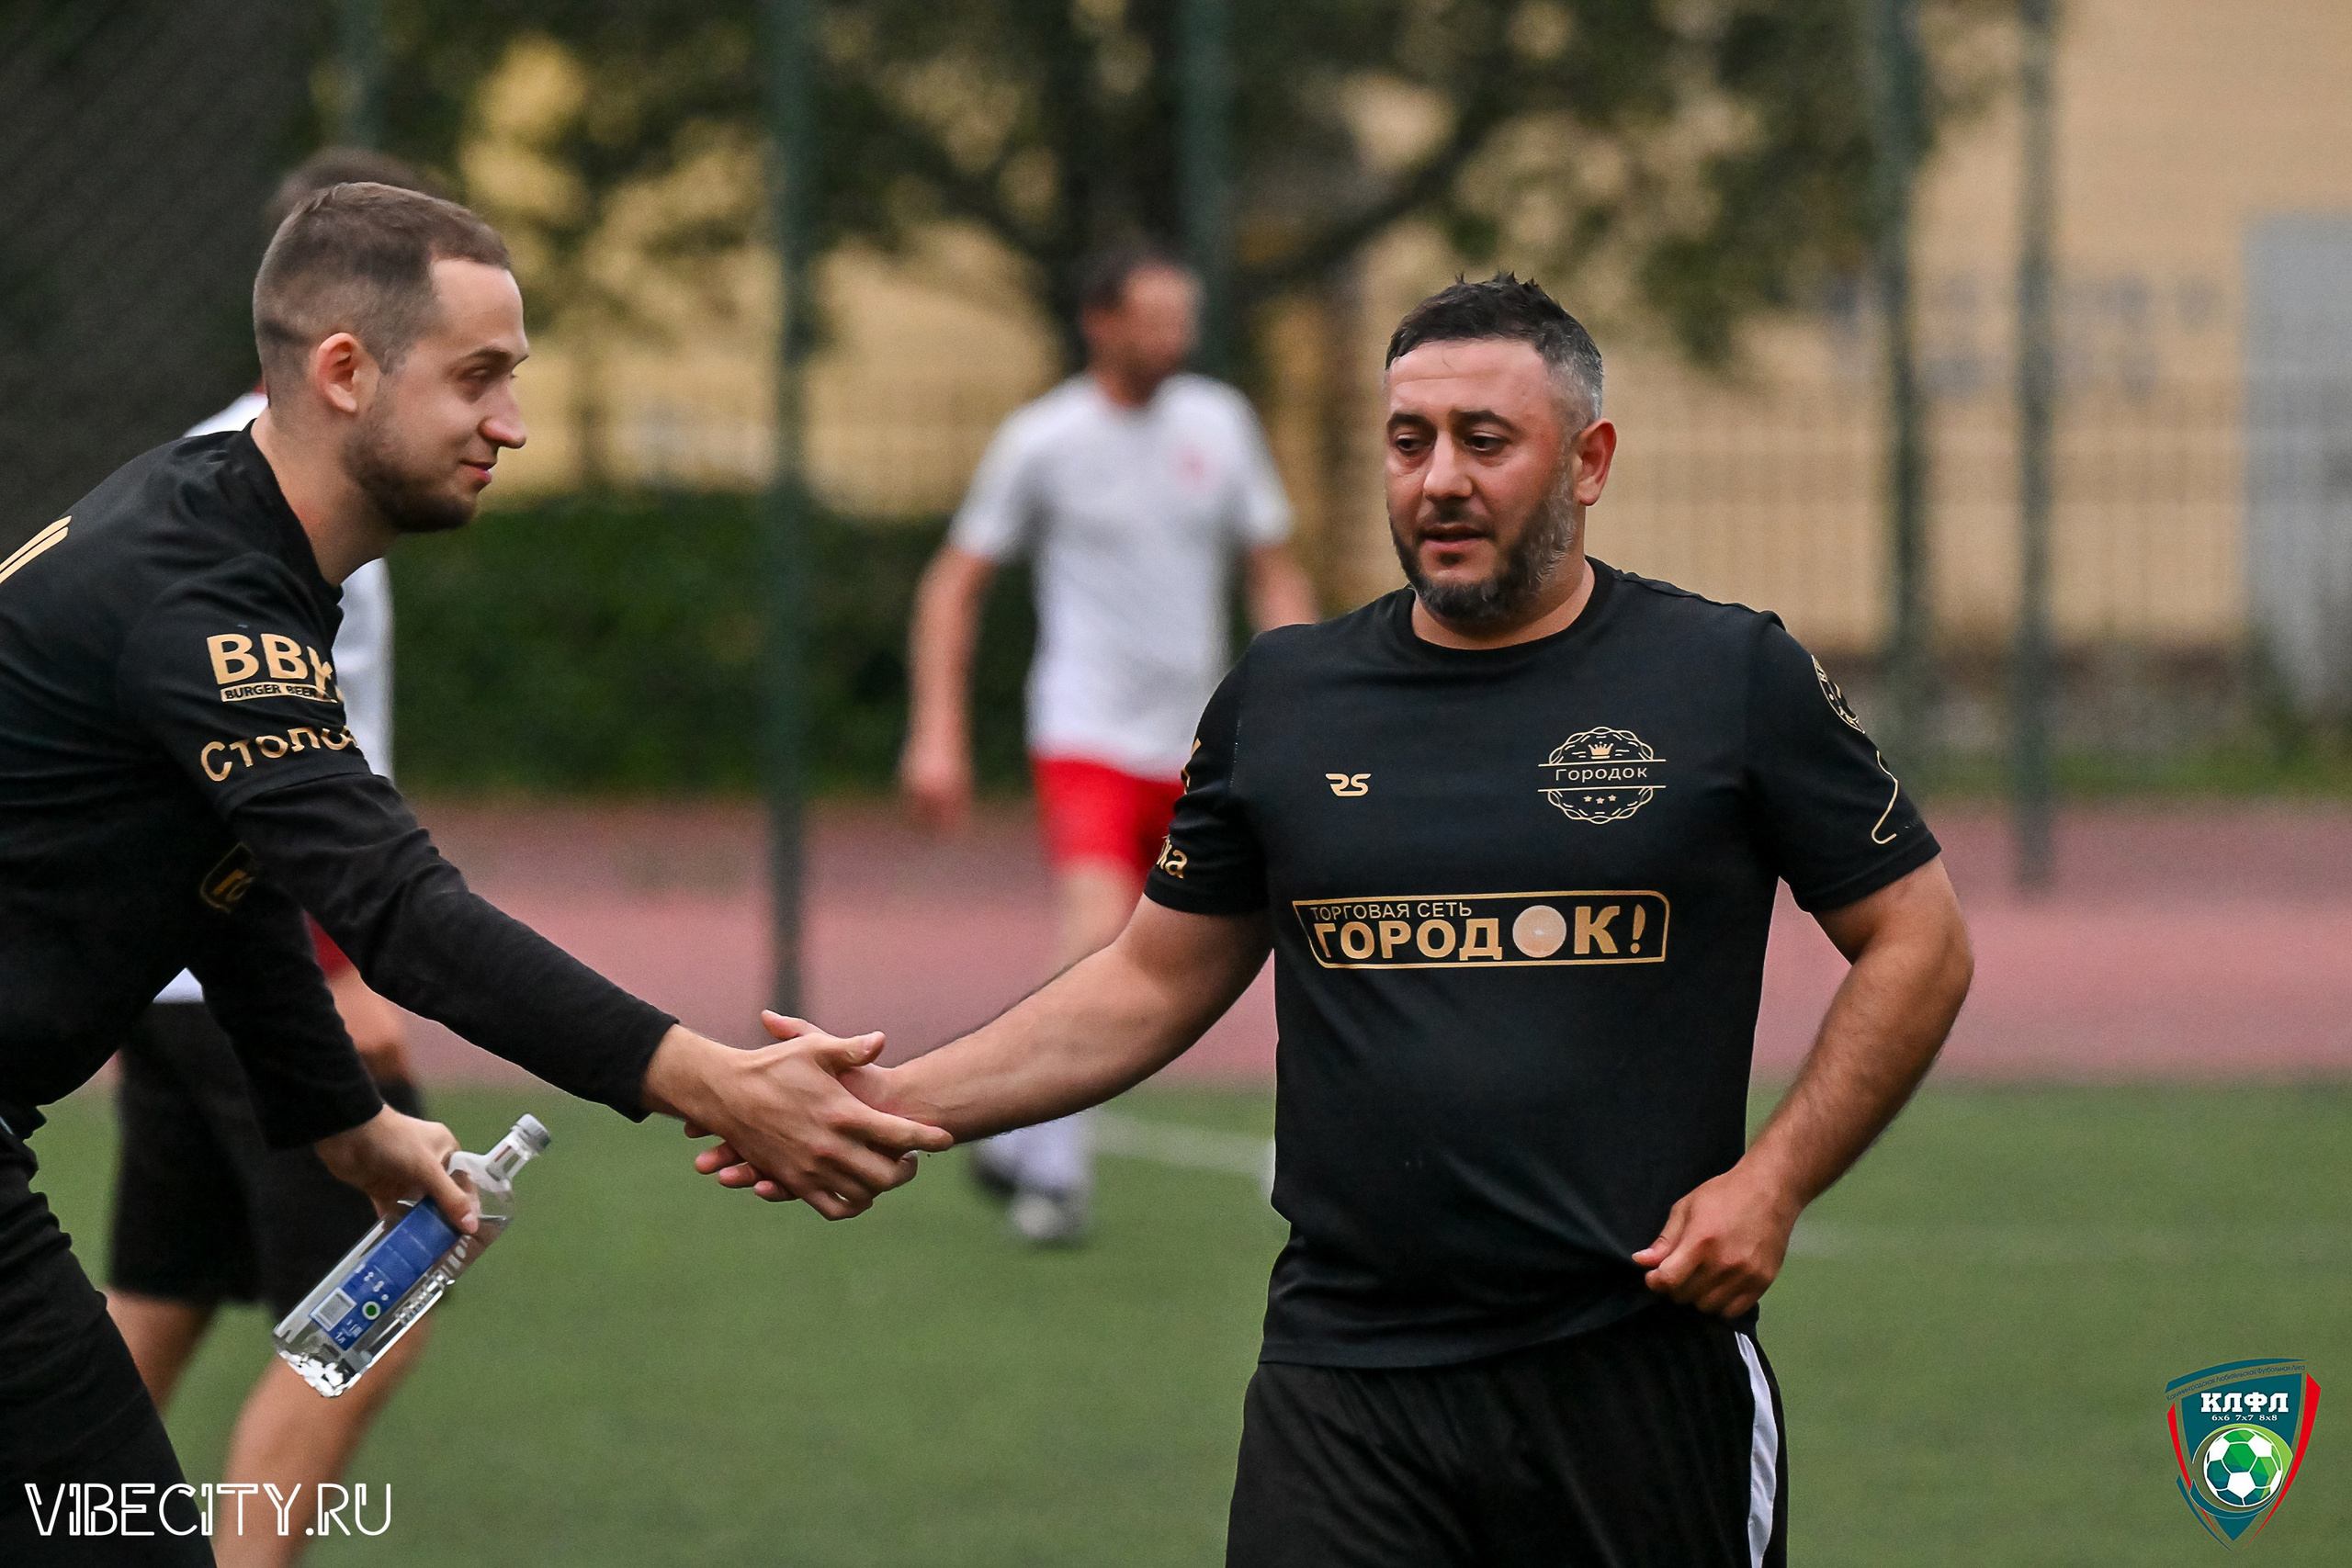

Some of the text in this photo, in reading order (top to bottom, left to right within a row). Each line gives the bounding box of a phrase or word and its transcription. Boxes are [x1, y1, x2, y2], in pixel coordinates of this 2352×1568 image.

[225, 684, 282, 699] BURGER
[1555, 767, 1647, 783] Городок
[1310, 902, 1472, 921] ТОРГОВАЯ СЕТЬ
